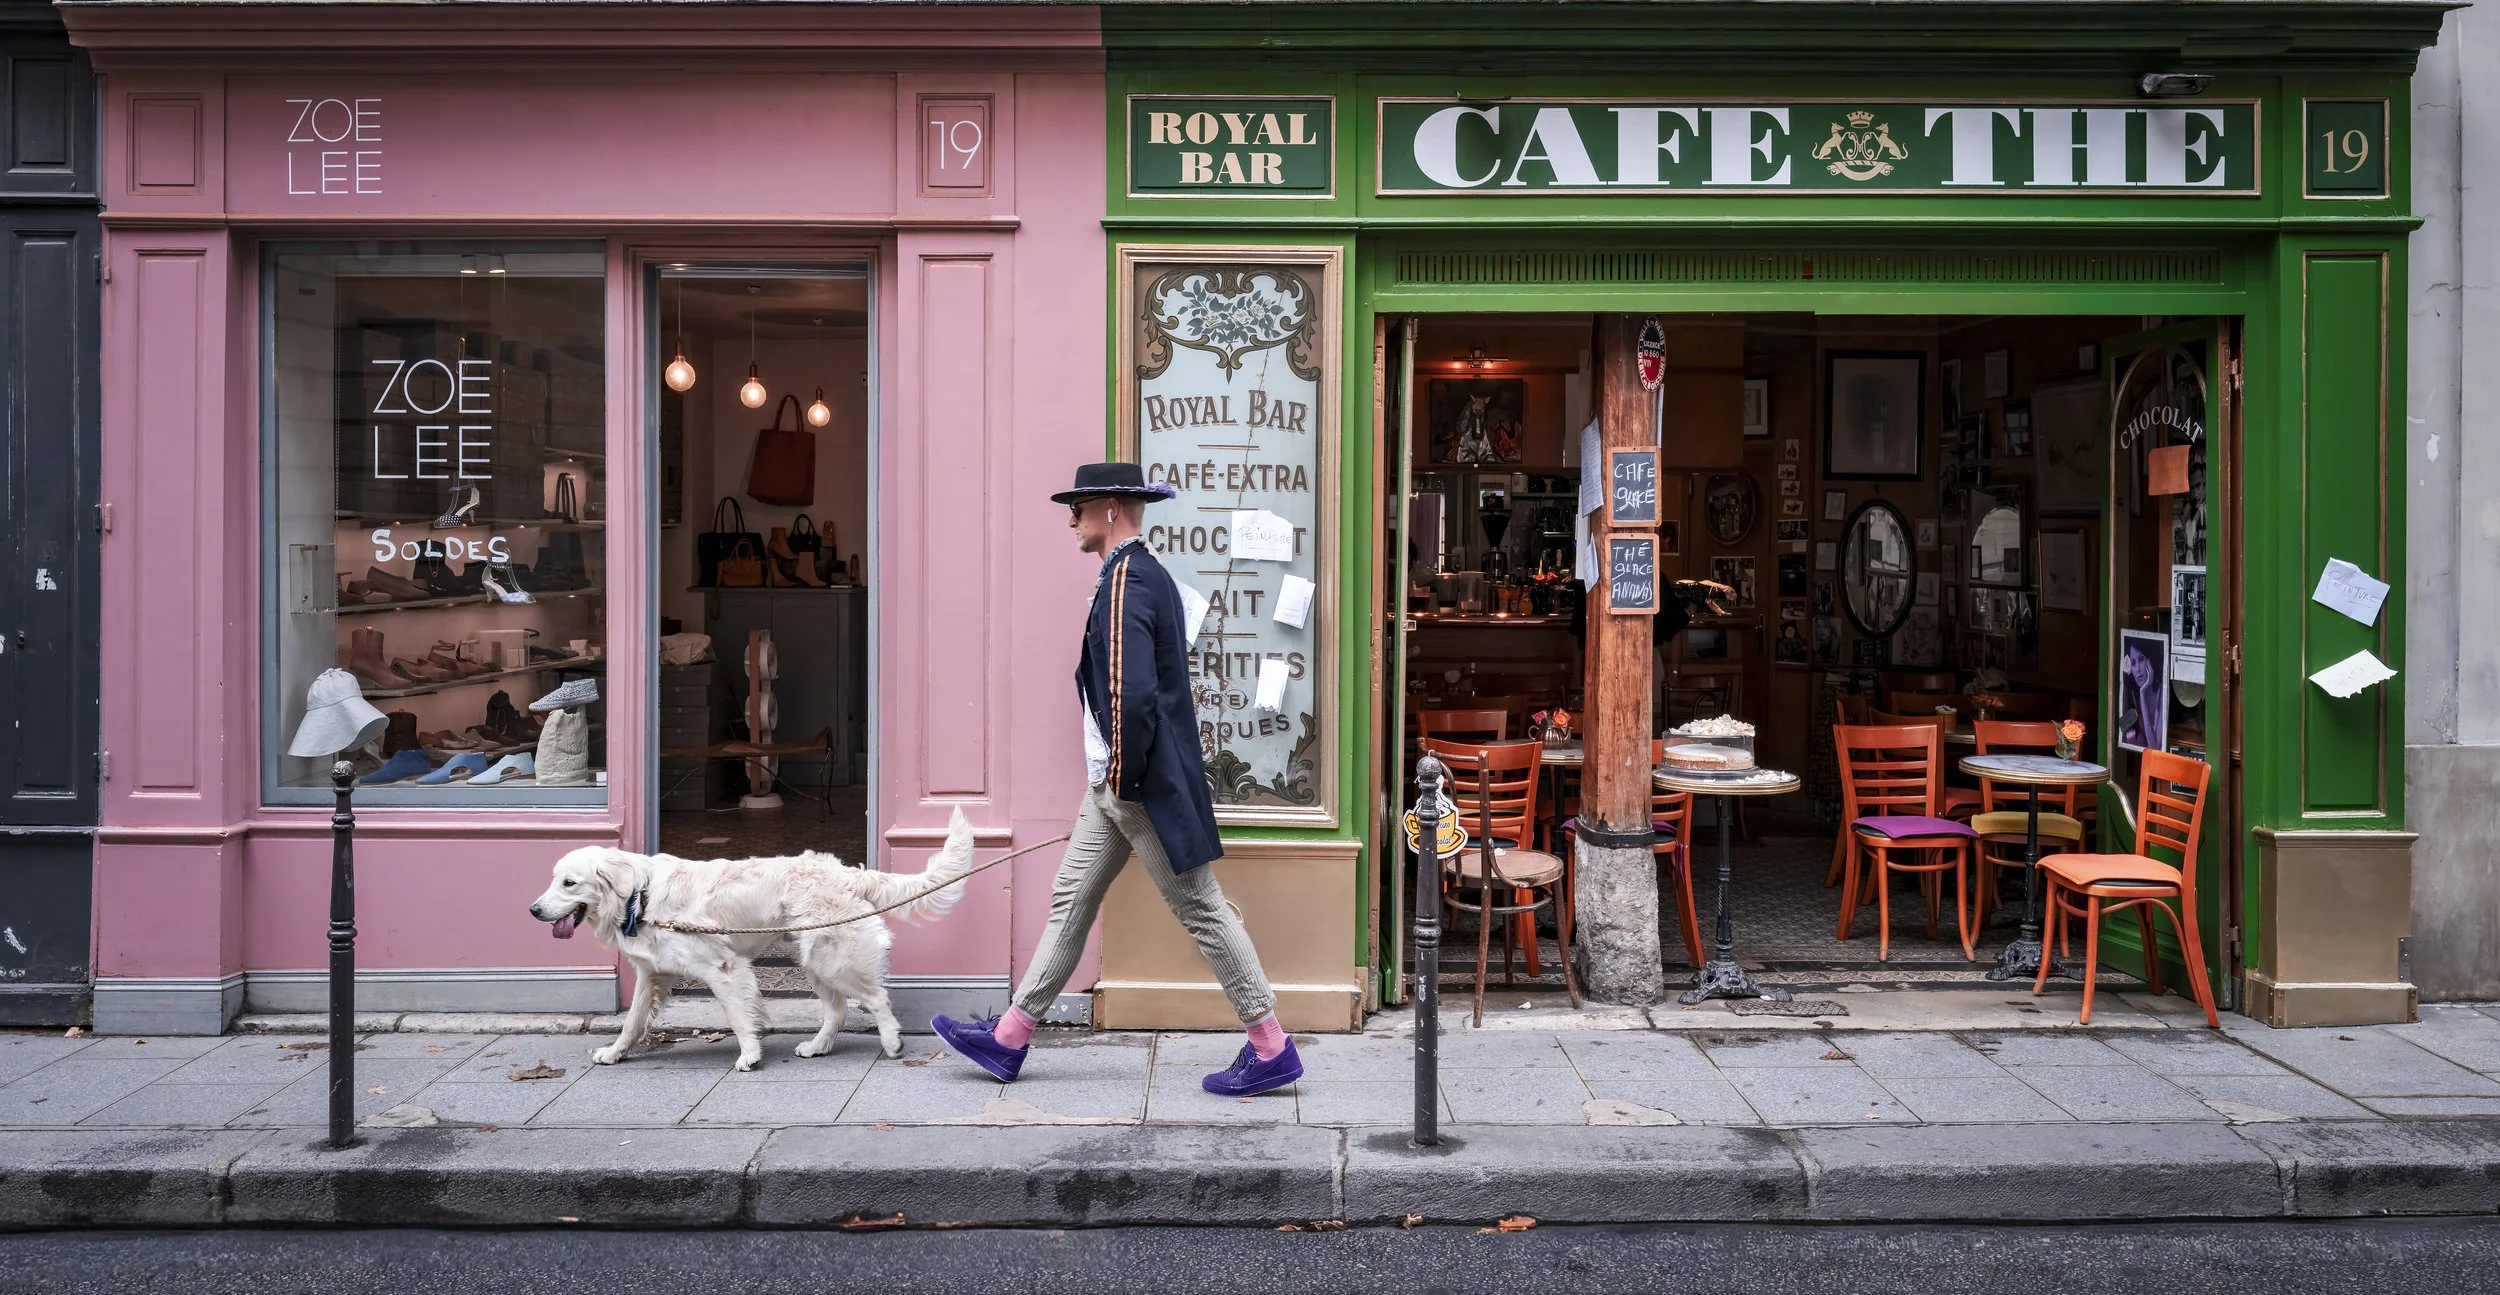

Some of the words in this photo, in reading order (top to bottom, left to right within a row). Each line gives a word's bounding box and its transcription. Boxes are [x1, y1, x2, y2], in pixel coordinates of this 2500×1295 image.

[286, 98, 382, 143] ZOE
[1147, 110, 1318, 147] ROYAL
[930, 119, 983, 171] 19
[1413, 106, 1792, 188] CAFE
[1924, 107, 2226, 187] THE
[2320, 128, 2370, 174] 19
[288, 150, 382, 195] LEE
[1178, 151, 1286, 186] BAR
[371, 358, 493, 415] ZOE
[1143, 394, 1240, 433] ROYAL
[1245, 389, 1310, 434] BAR
[2120, 405, 2204, 450] CHOCOLAT
[373, 425, 493, 480] LEE
[1147, 459, 1310, 493] CAFÉ-EXTRA
[1147, 524, 1308, 557] CHOCT
[1206, 589, 1266, 618] AIT
